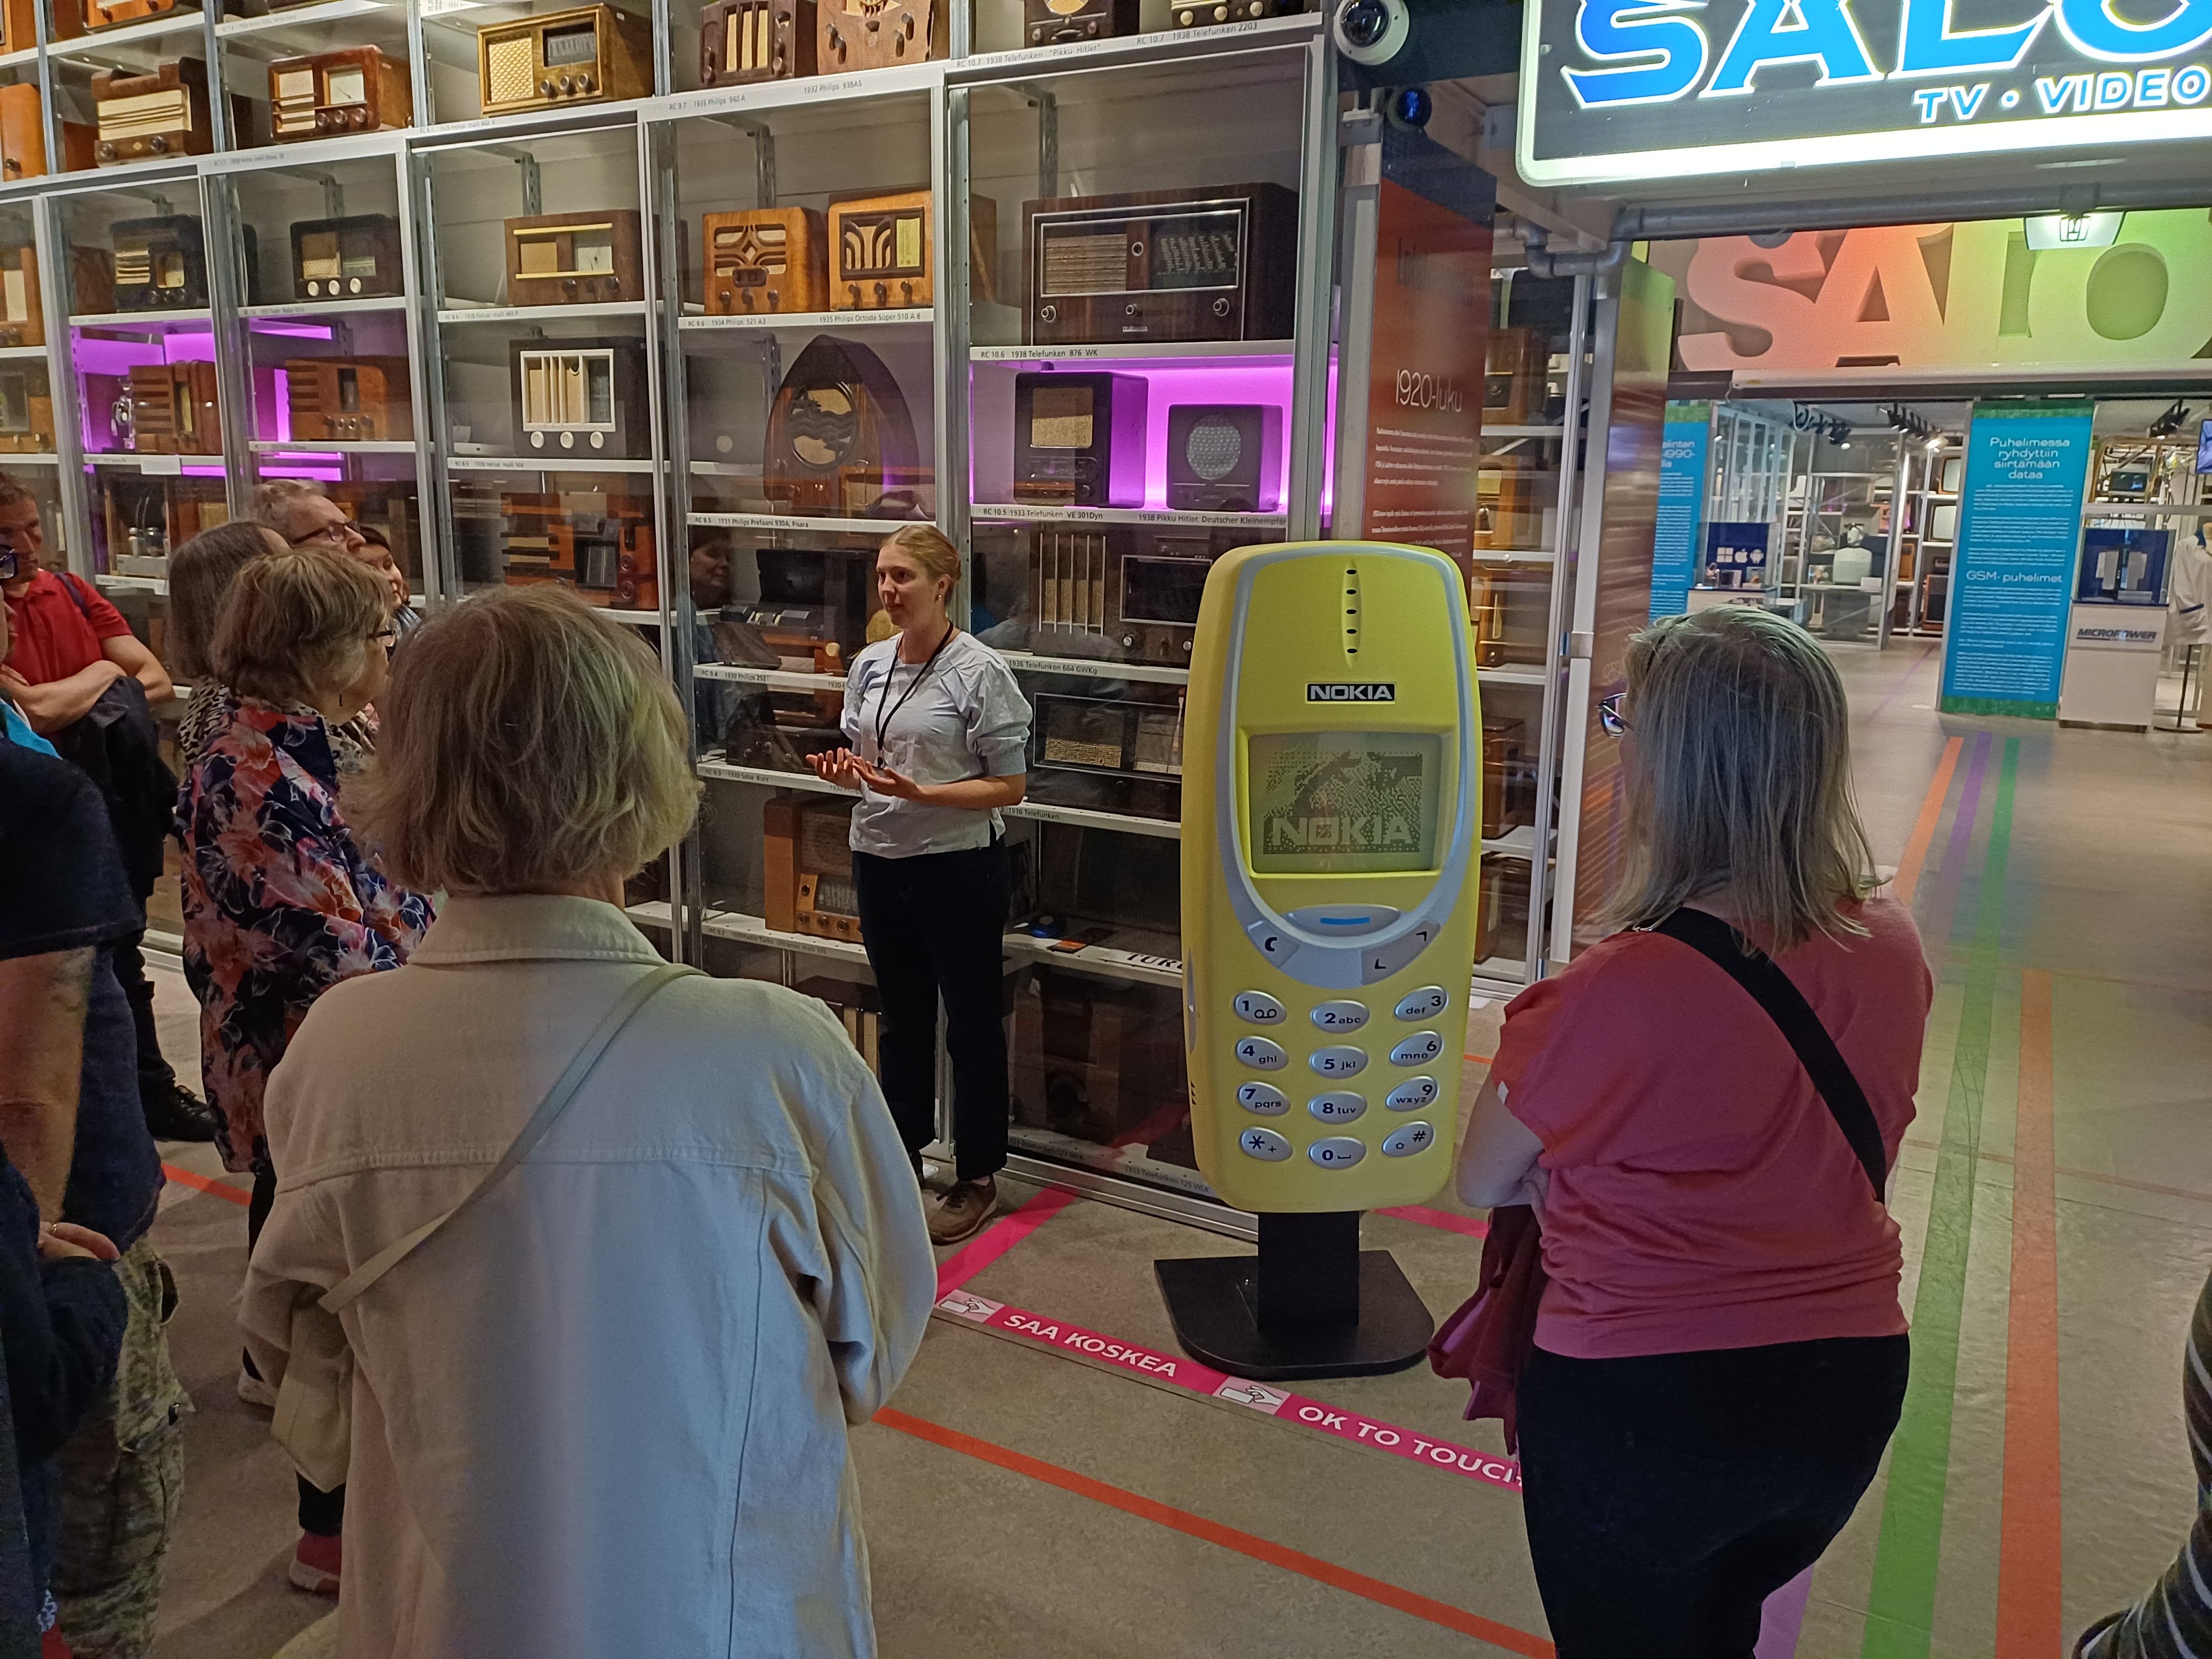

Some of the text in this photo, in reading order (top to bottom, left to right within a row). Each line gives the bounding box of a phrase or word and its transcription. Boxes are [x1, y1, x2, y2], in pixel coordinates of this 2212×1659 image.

[1150, 34, 1164, 44] 10.7
[1172, 30, 1190, 41] 1938
[1192, 25, 1237, 38] Telefunken
[1238, 22, 1258, 32] 2203
[968, 59, 981, 67] 10.7
[987, 56, 1002, 65] 1938
[1004, 51, 1042, 62] Telefunken
[820, 83, 839, 93] Philips
[1913, 65, 2211, 125] TV VIDEO
[879, 314, 895, 322] Super
[1396, 369, 1463, 413] 1920-luku
[1990, 437, 2070, 447] Puhelimessa
[2008, 469, 2043, 479] dataa
[1077, 512, 1103, 520] 301Dyn
[1157, 514, 1176, 522] Pikku
[1178, 515, 1199, 523] Hitler,
[1202, 516, 1238, 524] Deutscher
[2002, 572, 2063, 583] puhelimet
[1025, 661, 1061, 671] Telefunken
[1076, 666, 1097, 675] GWKg
[738, 673, 755, 681] Philips
[1310, 685, 1394, 701] NOKIA
[741, 773, 754, 781] Saba
[757, 774, 769, 782] Kurz
[1025, 809, 1060, 820] Telefunken
[1271, 815, 1414, 847] NOKIA
[1242, 1000, 1249, 1011] 1
[1406, 995, 1442, 1015] def 3
[1324, 1013, 1361, 1024] 2 abc
[1242, 1045, 1255, 1057] 4
[1426, 1040, 1437, 1052] 6
[1324, 1058, 1356, 1071] 5 jkl
[1244, 1088, 1281, 1109] 7 pqrs
[1396, 1084, 1433, 1105] wxyz 9
[1322, 1103, 1334, 1114] 8
[1142, 1170, 1178, 1184] Telefunken
[1003, 1314, 1176, 1377] SAA KOSKEA
[1298, 1406, 1348, 1431] OK
[1358, 1422, 1400, 1445] TO
